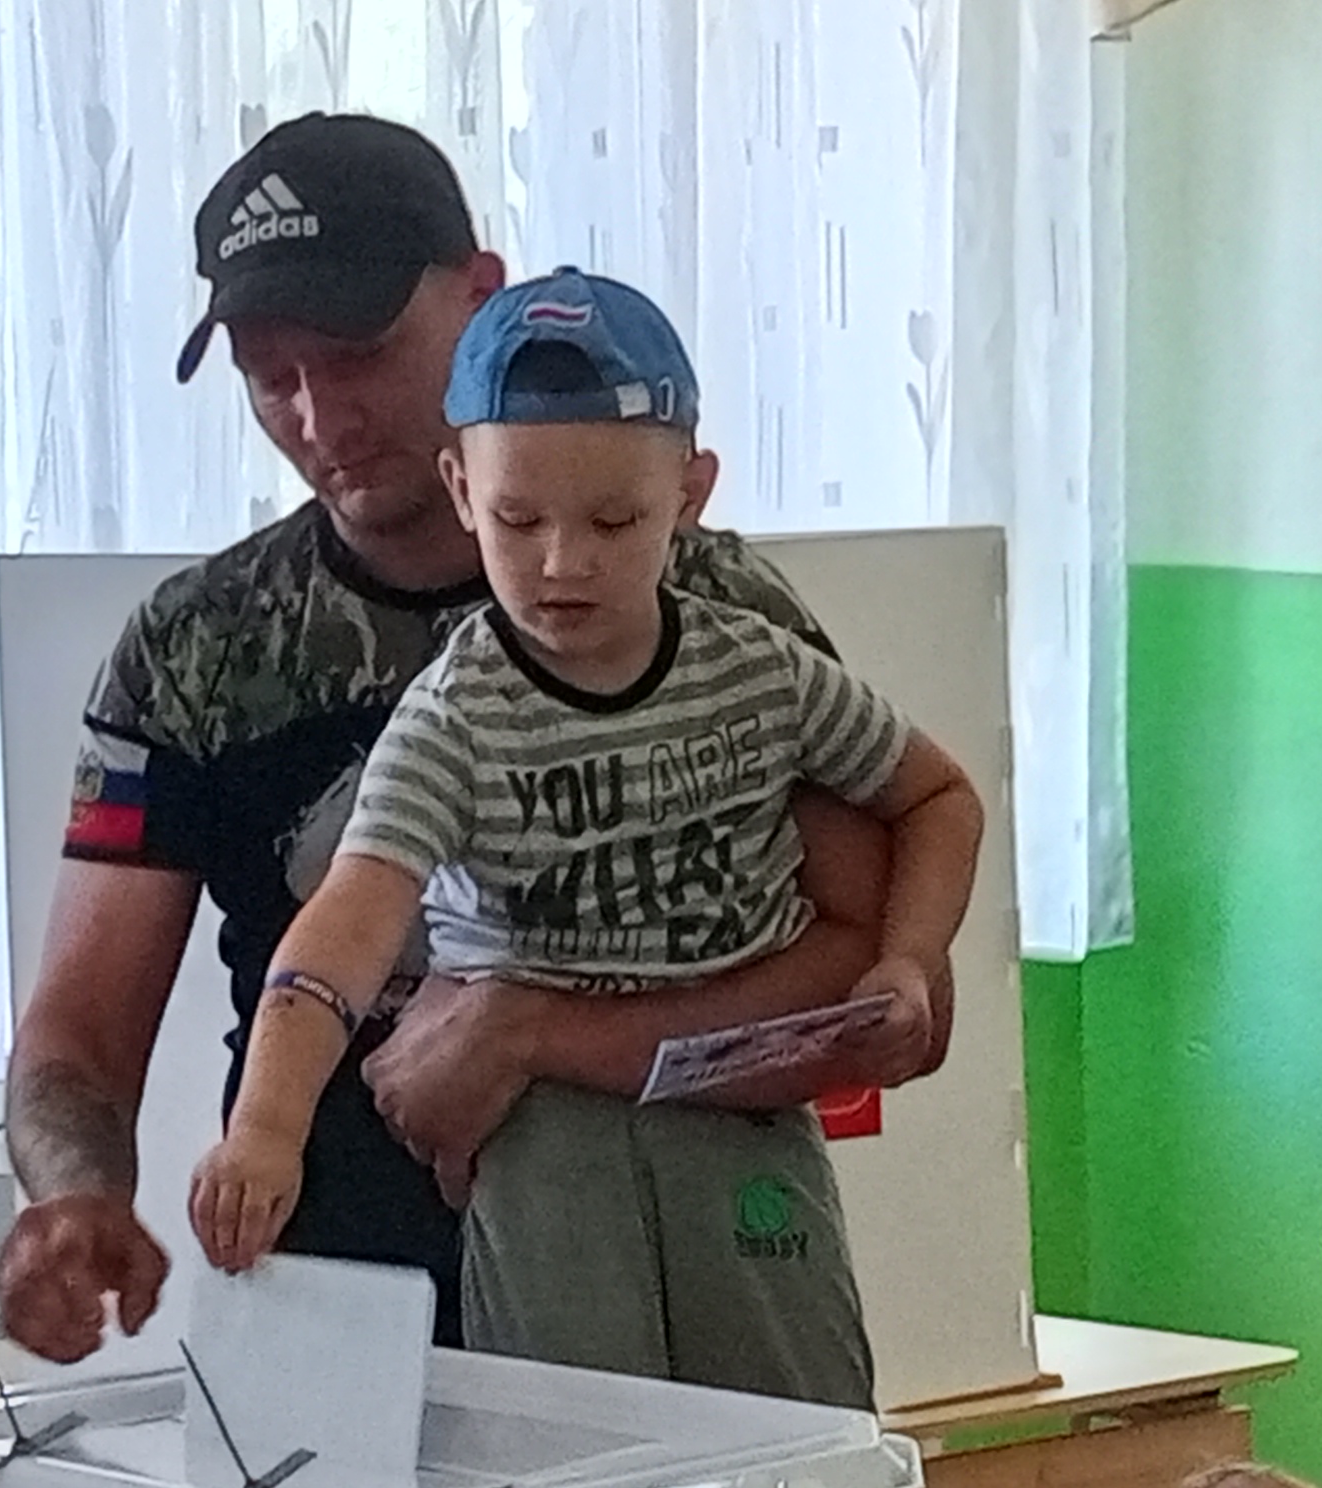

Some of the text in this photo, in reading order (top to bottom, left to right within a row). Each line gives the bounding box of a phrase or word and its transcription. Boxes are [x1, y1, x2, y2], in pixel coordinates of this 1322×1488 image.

[219, 211, 319, 260] adidas
[506, 714, 767, 838] YOU ARE
